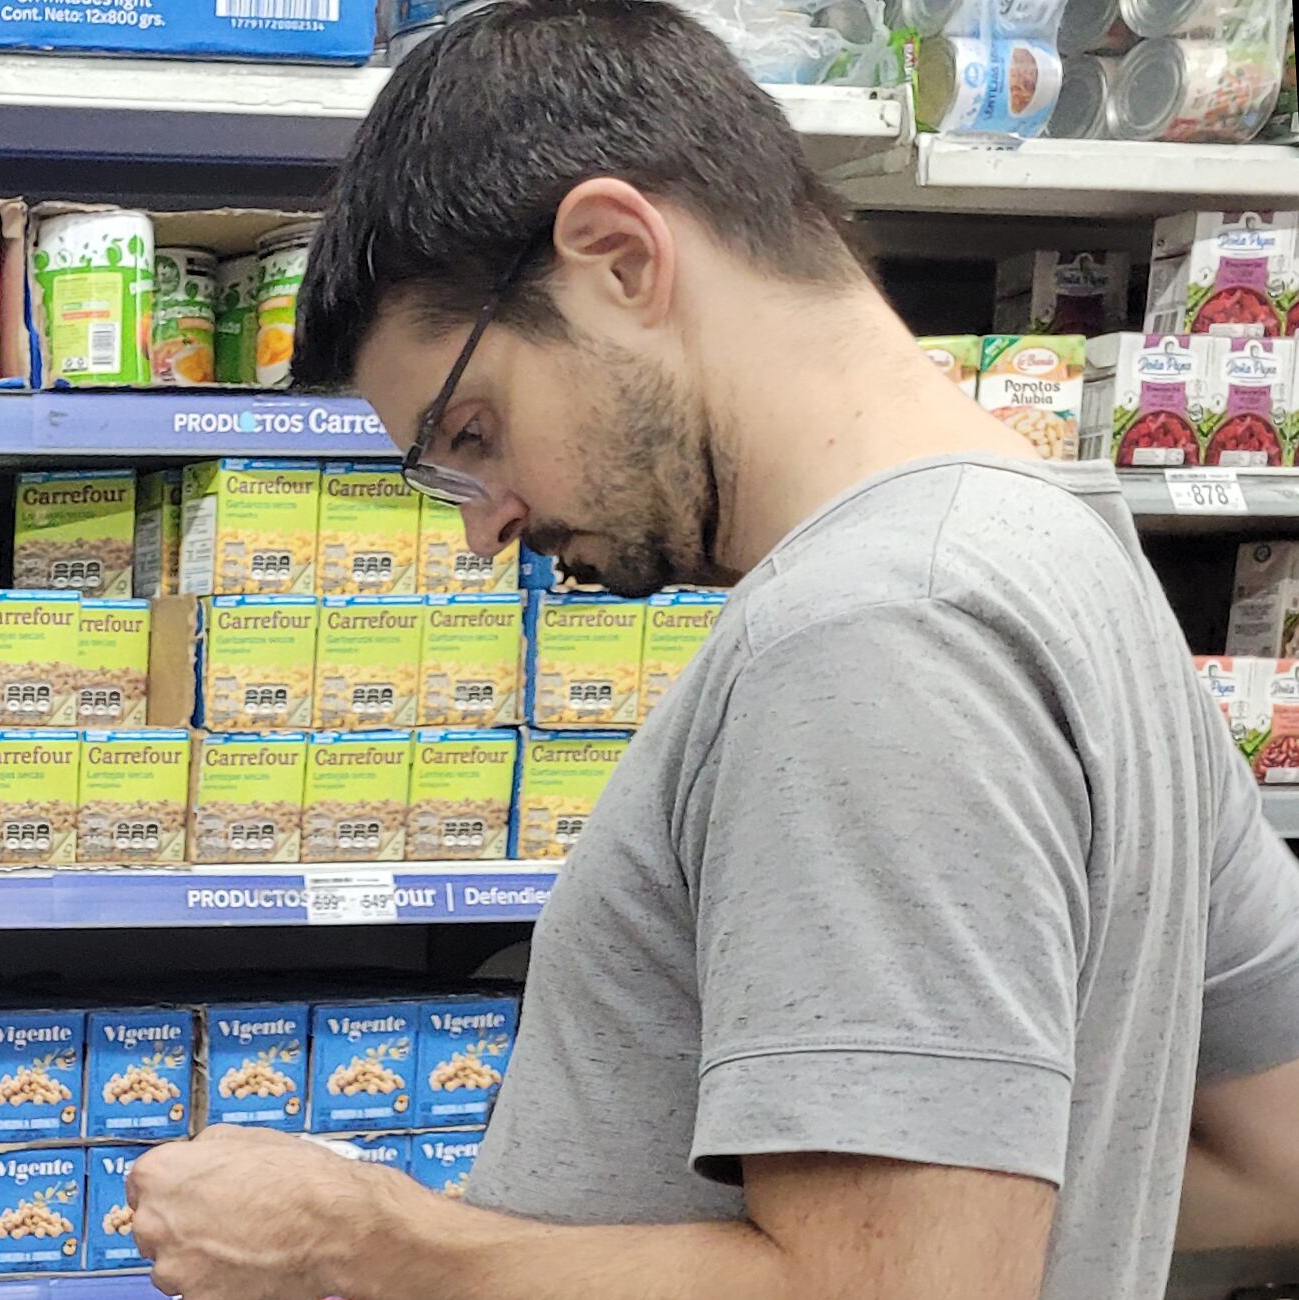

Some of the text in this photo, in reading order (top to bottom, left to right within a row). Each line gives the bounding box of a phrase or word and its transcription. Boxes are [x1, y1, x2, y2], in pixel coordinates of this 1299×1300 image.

[2, 7, 166, 27] Cont. Neto: 12x800 grs.
[1005, 381, 1060, 394] Porotos
[1011, 393, 1053, 405] Alubia
[309, 410, 384, 432] Carre
[23, 486, 127, 505] Carrefour
[227, 476, 312, 497] Carrefour
[327, 613, 417, 630] Carrefour
[88, 747, 182, 766] Carrefour
[315, 748, 404, 766] Carrefour
[188, 889, 309, 908] PRODUCTOS
[219, 1019, 296, 1043] Vigente
[328, 1016, 406, 1040] Vigente
